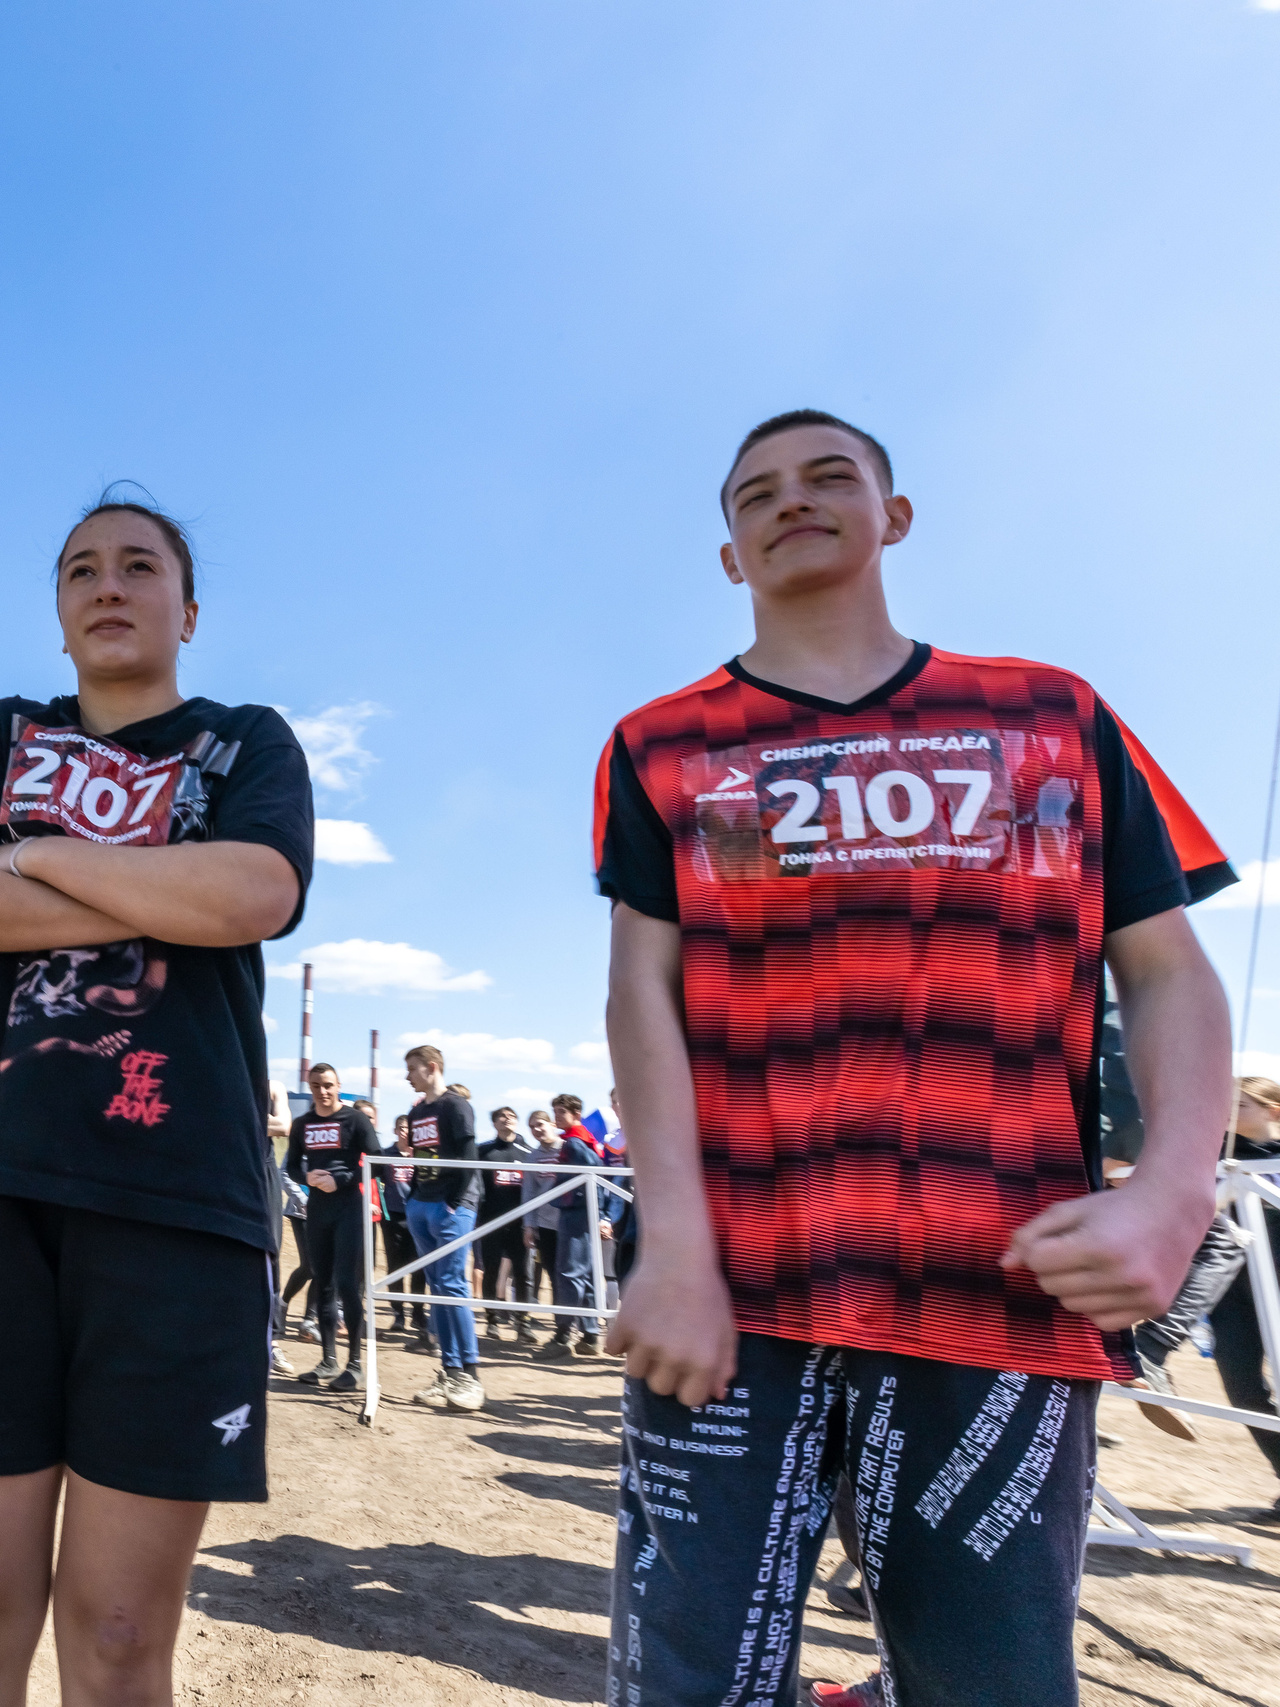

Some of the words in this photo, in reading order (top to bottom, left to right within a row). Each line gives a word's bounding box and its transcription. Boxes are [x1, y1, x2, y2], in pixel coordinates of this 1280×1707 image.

[760, 736, 890, 763] СИБИРСКИЙ
[898, 735, 992, 753] ПРЕДЕЛ
[10, 800, 48, 813] ГОНКА
[12, 747, 171, 829] 2107
[765, 769, 992, 844] 2107
[780, 850, 832, 866] ГОНКА
[835, 850, 849, 862] С
[866, 1376, 897, 1448] RESULTS
[981, 1382, 1021, 1424] AMONG
[958, 1437, 988, 1462] OF
[964, 1412, 1006, 1450] USERS
[857, 1447, 881, 1490] THAT
[874, 1429, 906, 1513] COMPUTER
[938, 1447, 980, 1496] COMPUTER
[869, 1511, 891, 1545] THE
[719, 1628, 758, 1707] CULTURE
[746, 1607, 763, 1624] IS
[758, 1498, 787, 1583] CULTURE
[776, 1420, 807, 1494] ENDEMIC
[798, 1393, 815, 1418] TO
[865, 1543, 884, 1569] BY
[765, 1611, 783, 1649] NOT
[775, 1555, 790, 1604] JUST
[765, 1608, 793, 1693] DIRECTLY
